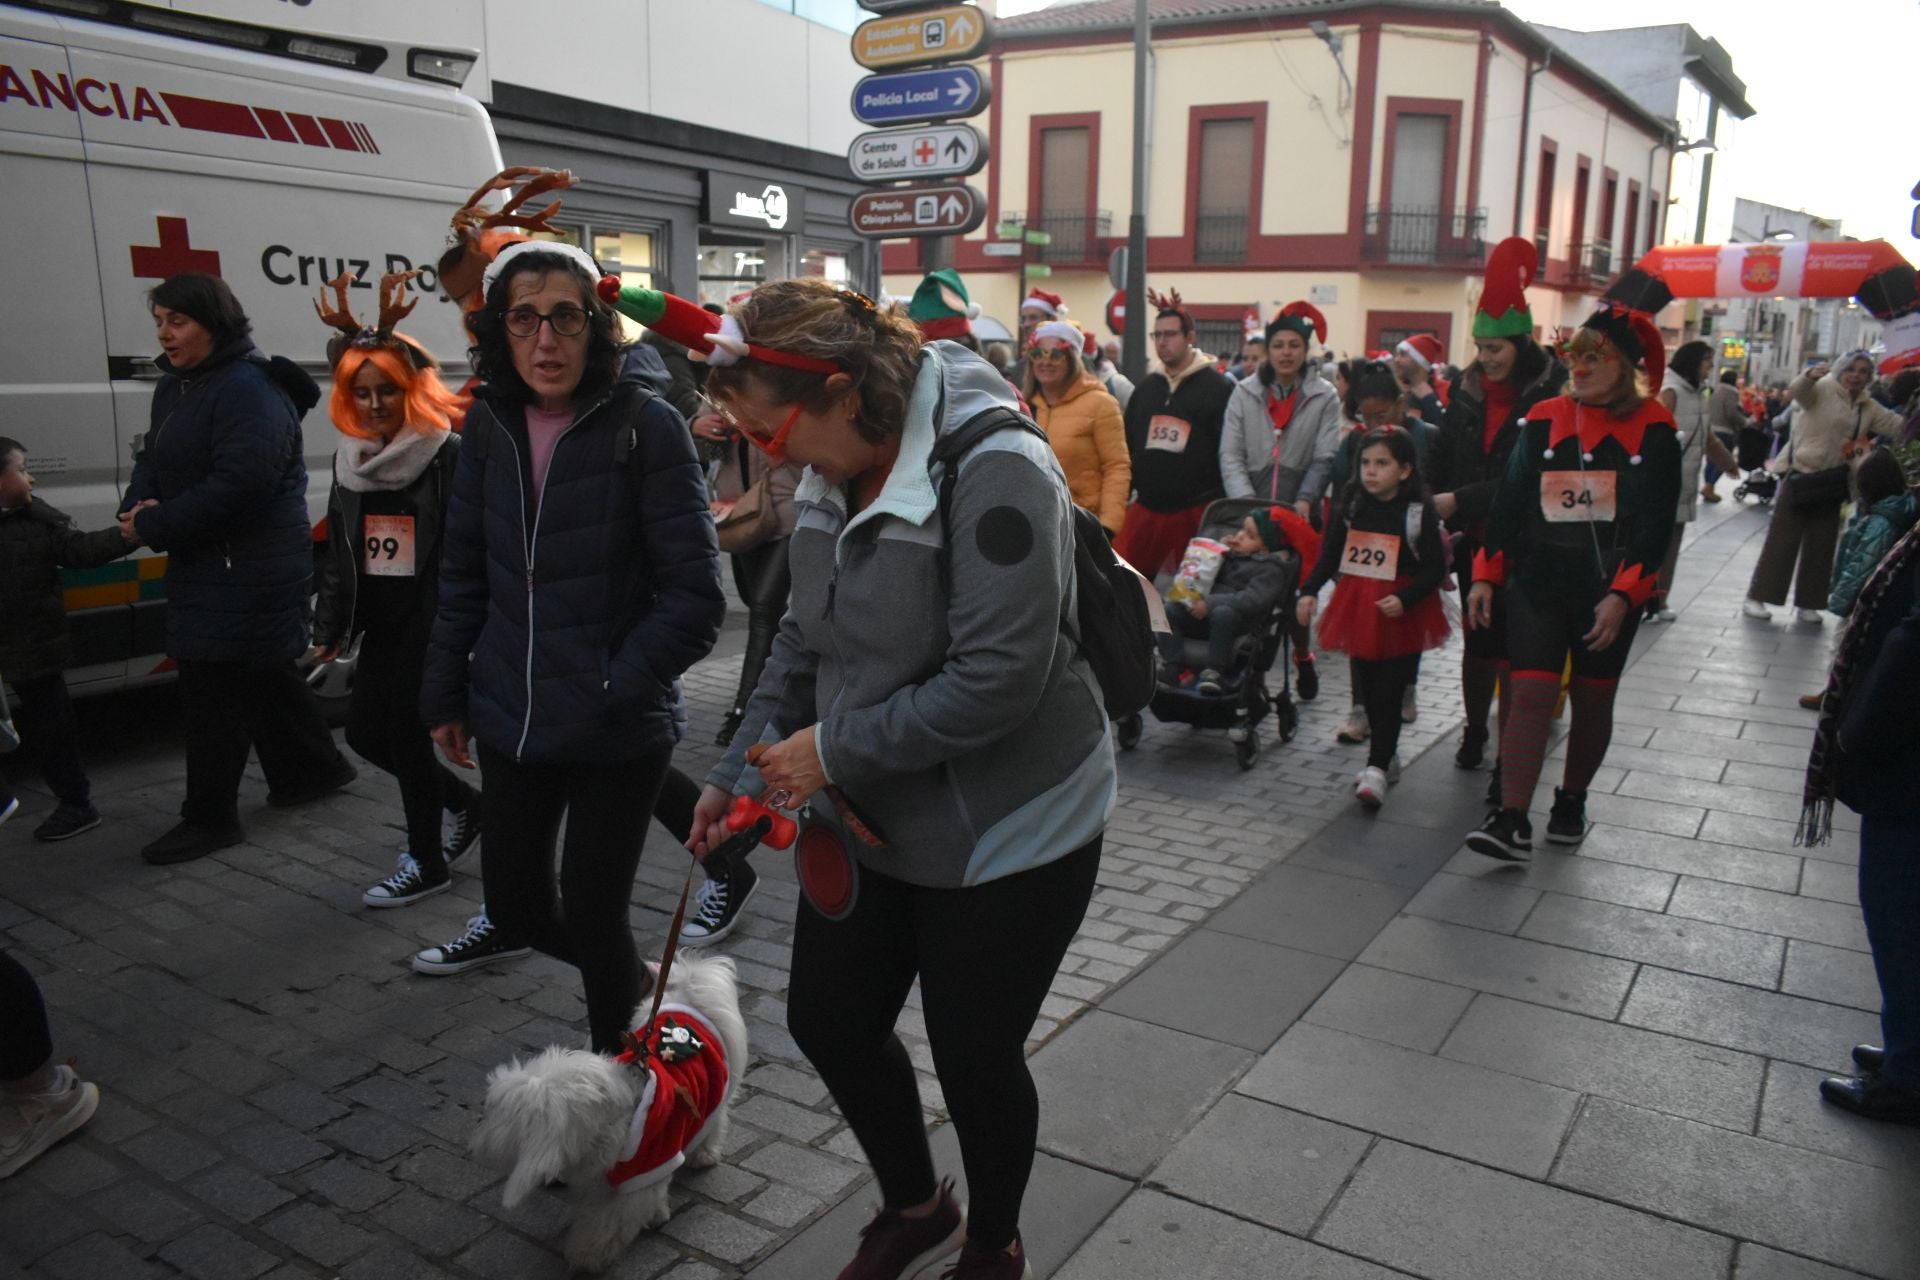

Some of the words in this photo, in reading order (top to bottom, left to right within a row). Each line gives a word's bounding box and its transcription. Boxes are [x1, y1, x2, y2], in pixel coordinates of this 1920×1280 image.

[0, 64, 171, 126] ANCIA
[905, 87, 940, 104] Local
[862, 142, 898, 154] Centro
[862, 159, 875, 170] de
[878, 156, 907, 170] Salud
[261, 244, 373, 289] Cruz
[1561, 489, 1593, 509] 34
[367, 536, 399, 560] 99
[1348, 546, 1386, 567] 229
